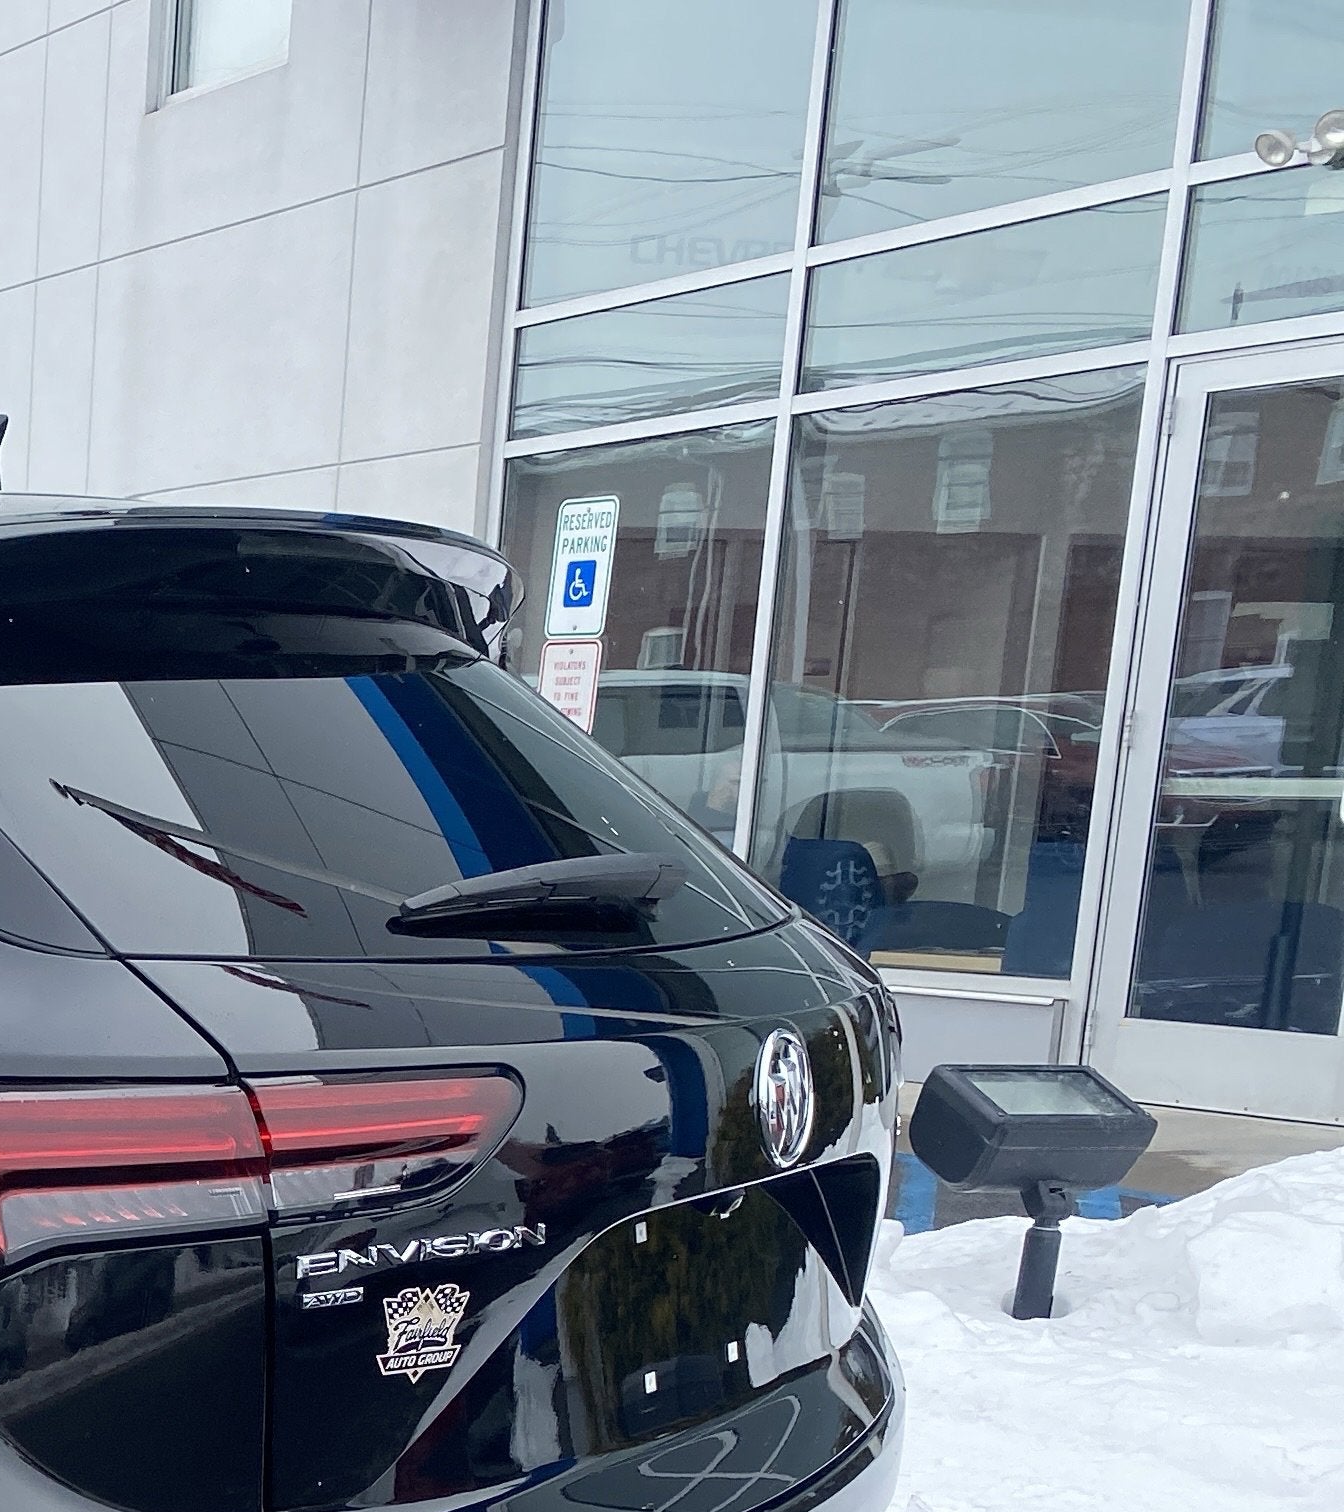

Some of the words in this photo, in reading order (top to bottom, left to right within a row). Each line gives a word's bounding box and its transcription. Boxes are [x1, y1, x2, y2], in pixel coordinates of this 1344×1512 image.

[562, 511, 612, 531] RESERVED
[561, 535, 609, 555] PARKING
[297, 1222, 546, 1280] ENVISION
[303, 1289, 363, 1308] AWD
[393, 1316, 456, 1352] Fairfield
[385, 1355, 417, 1370] AUTO
[417, 1350, 454, 1366] GROUP
